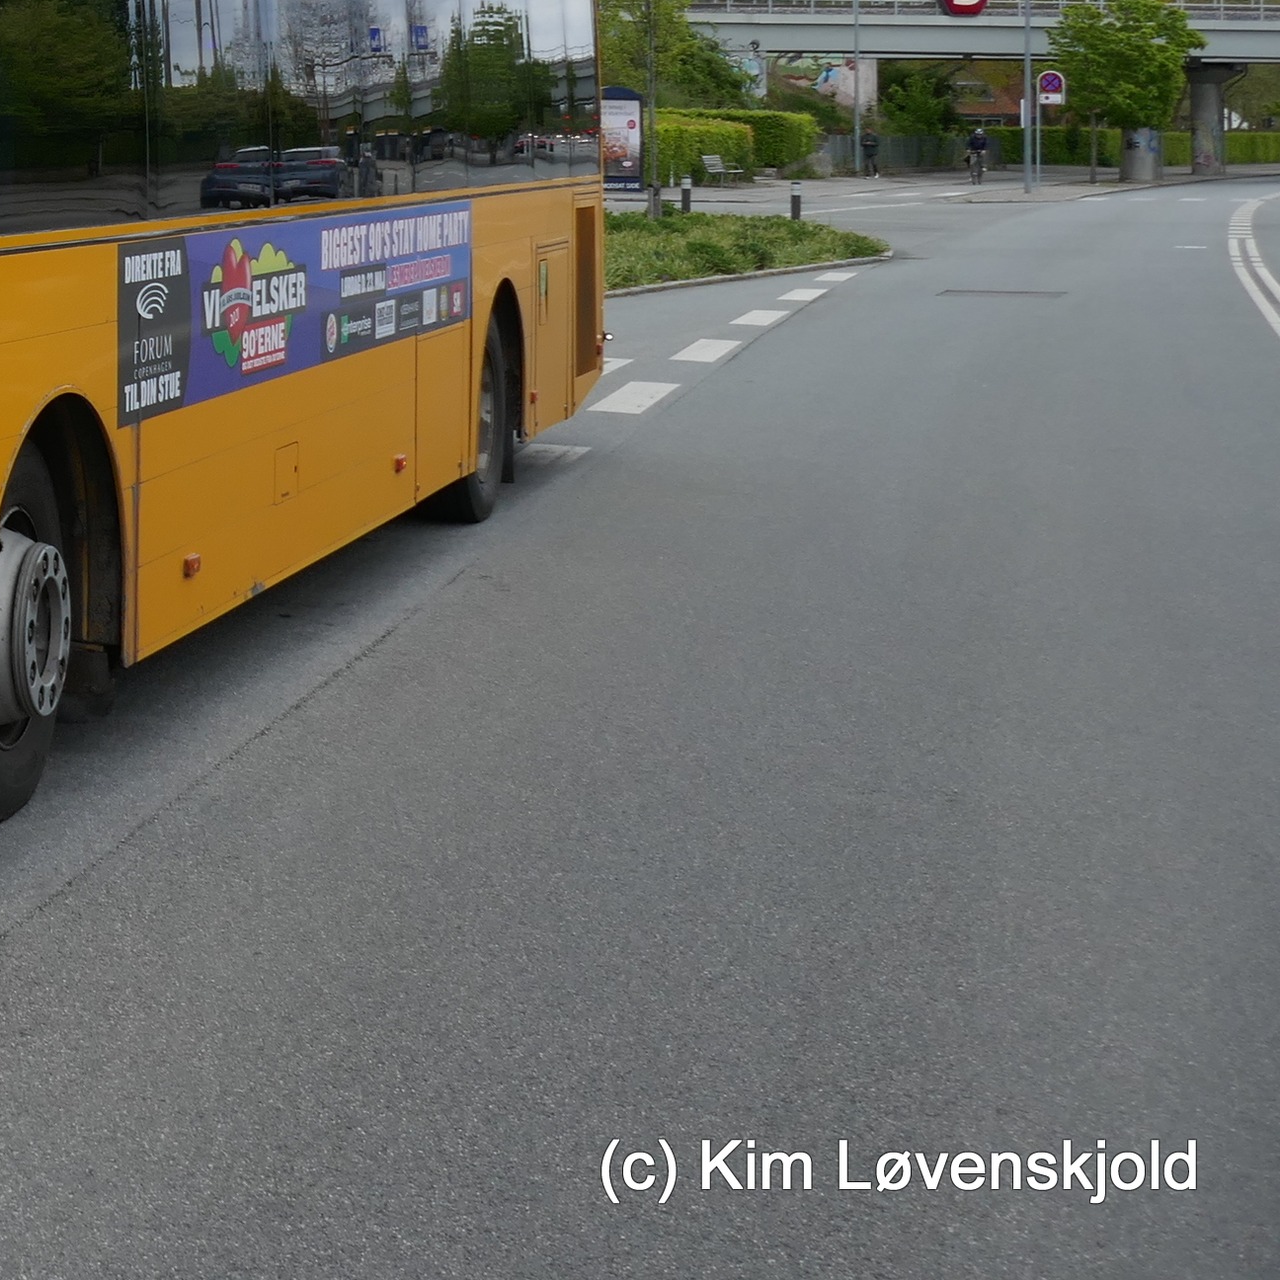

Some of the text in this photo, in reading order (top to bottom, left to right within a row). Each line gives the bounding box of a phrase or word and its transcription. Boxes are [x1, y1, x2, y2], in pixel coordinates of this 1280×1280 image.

[321, 210, 469, 270] BIGGEST 90'S STAY HOME PARTY
[124, 249, 182, 284] DIREKTE FRA
[203, 272, 306, 329] VI ELSKER
[134, 334, 172, 365] FORUM
[242, 322, 285, 359] 90'ERNE
[134, 360, 172, 380] COPENHAGEN
[124, 371, 181, 413] TIL DIN STUE
